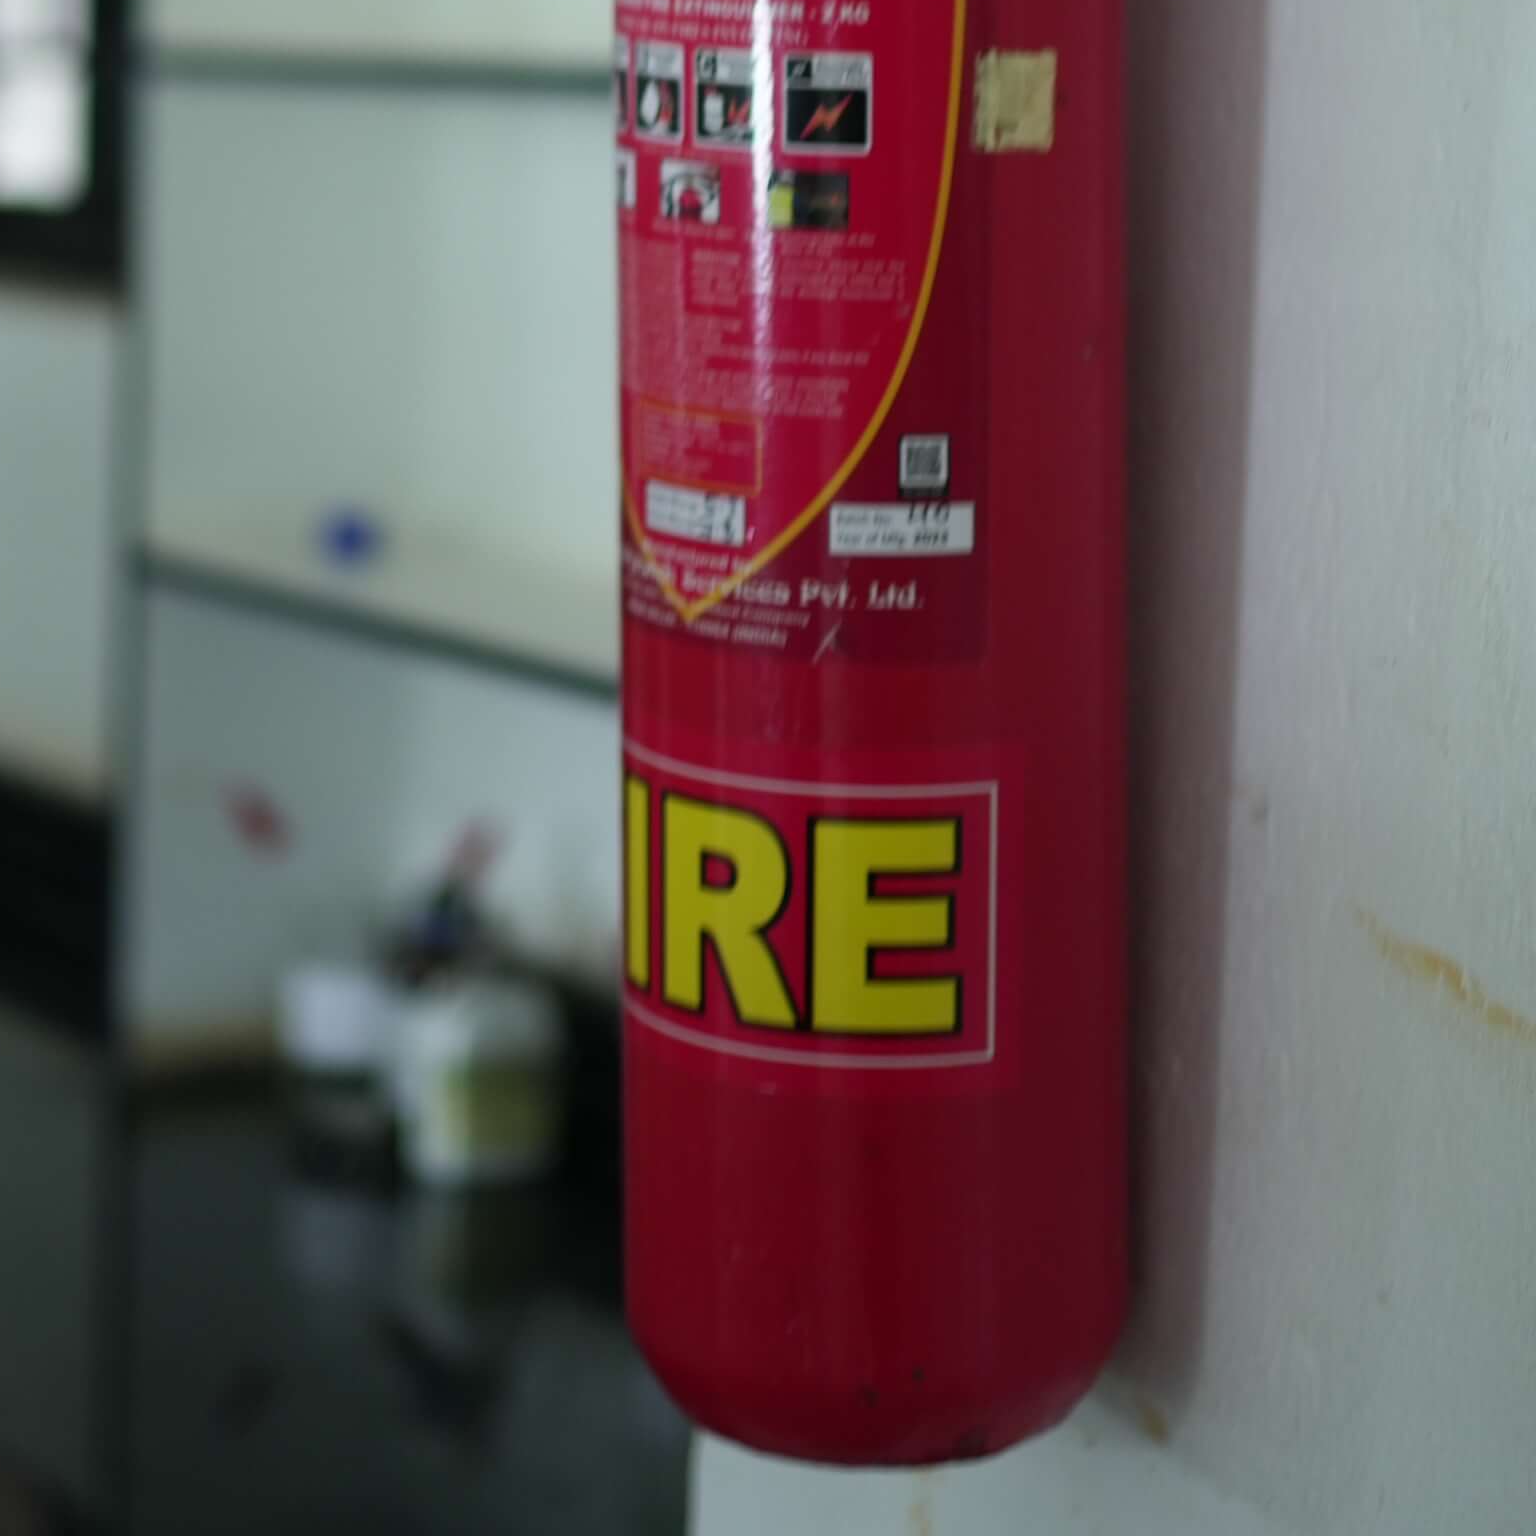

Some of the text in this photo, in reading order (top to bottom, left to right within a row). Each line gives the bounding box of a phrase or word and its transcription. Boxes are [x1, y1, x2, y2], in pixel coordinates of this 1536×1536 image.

[839, 0, 871, 25] KG
[865, 578, 924, 610] Ltd.
[625, 771, 963, 1037] IRE
